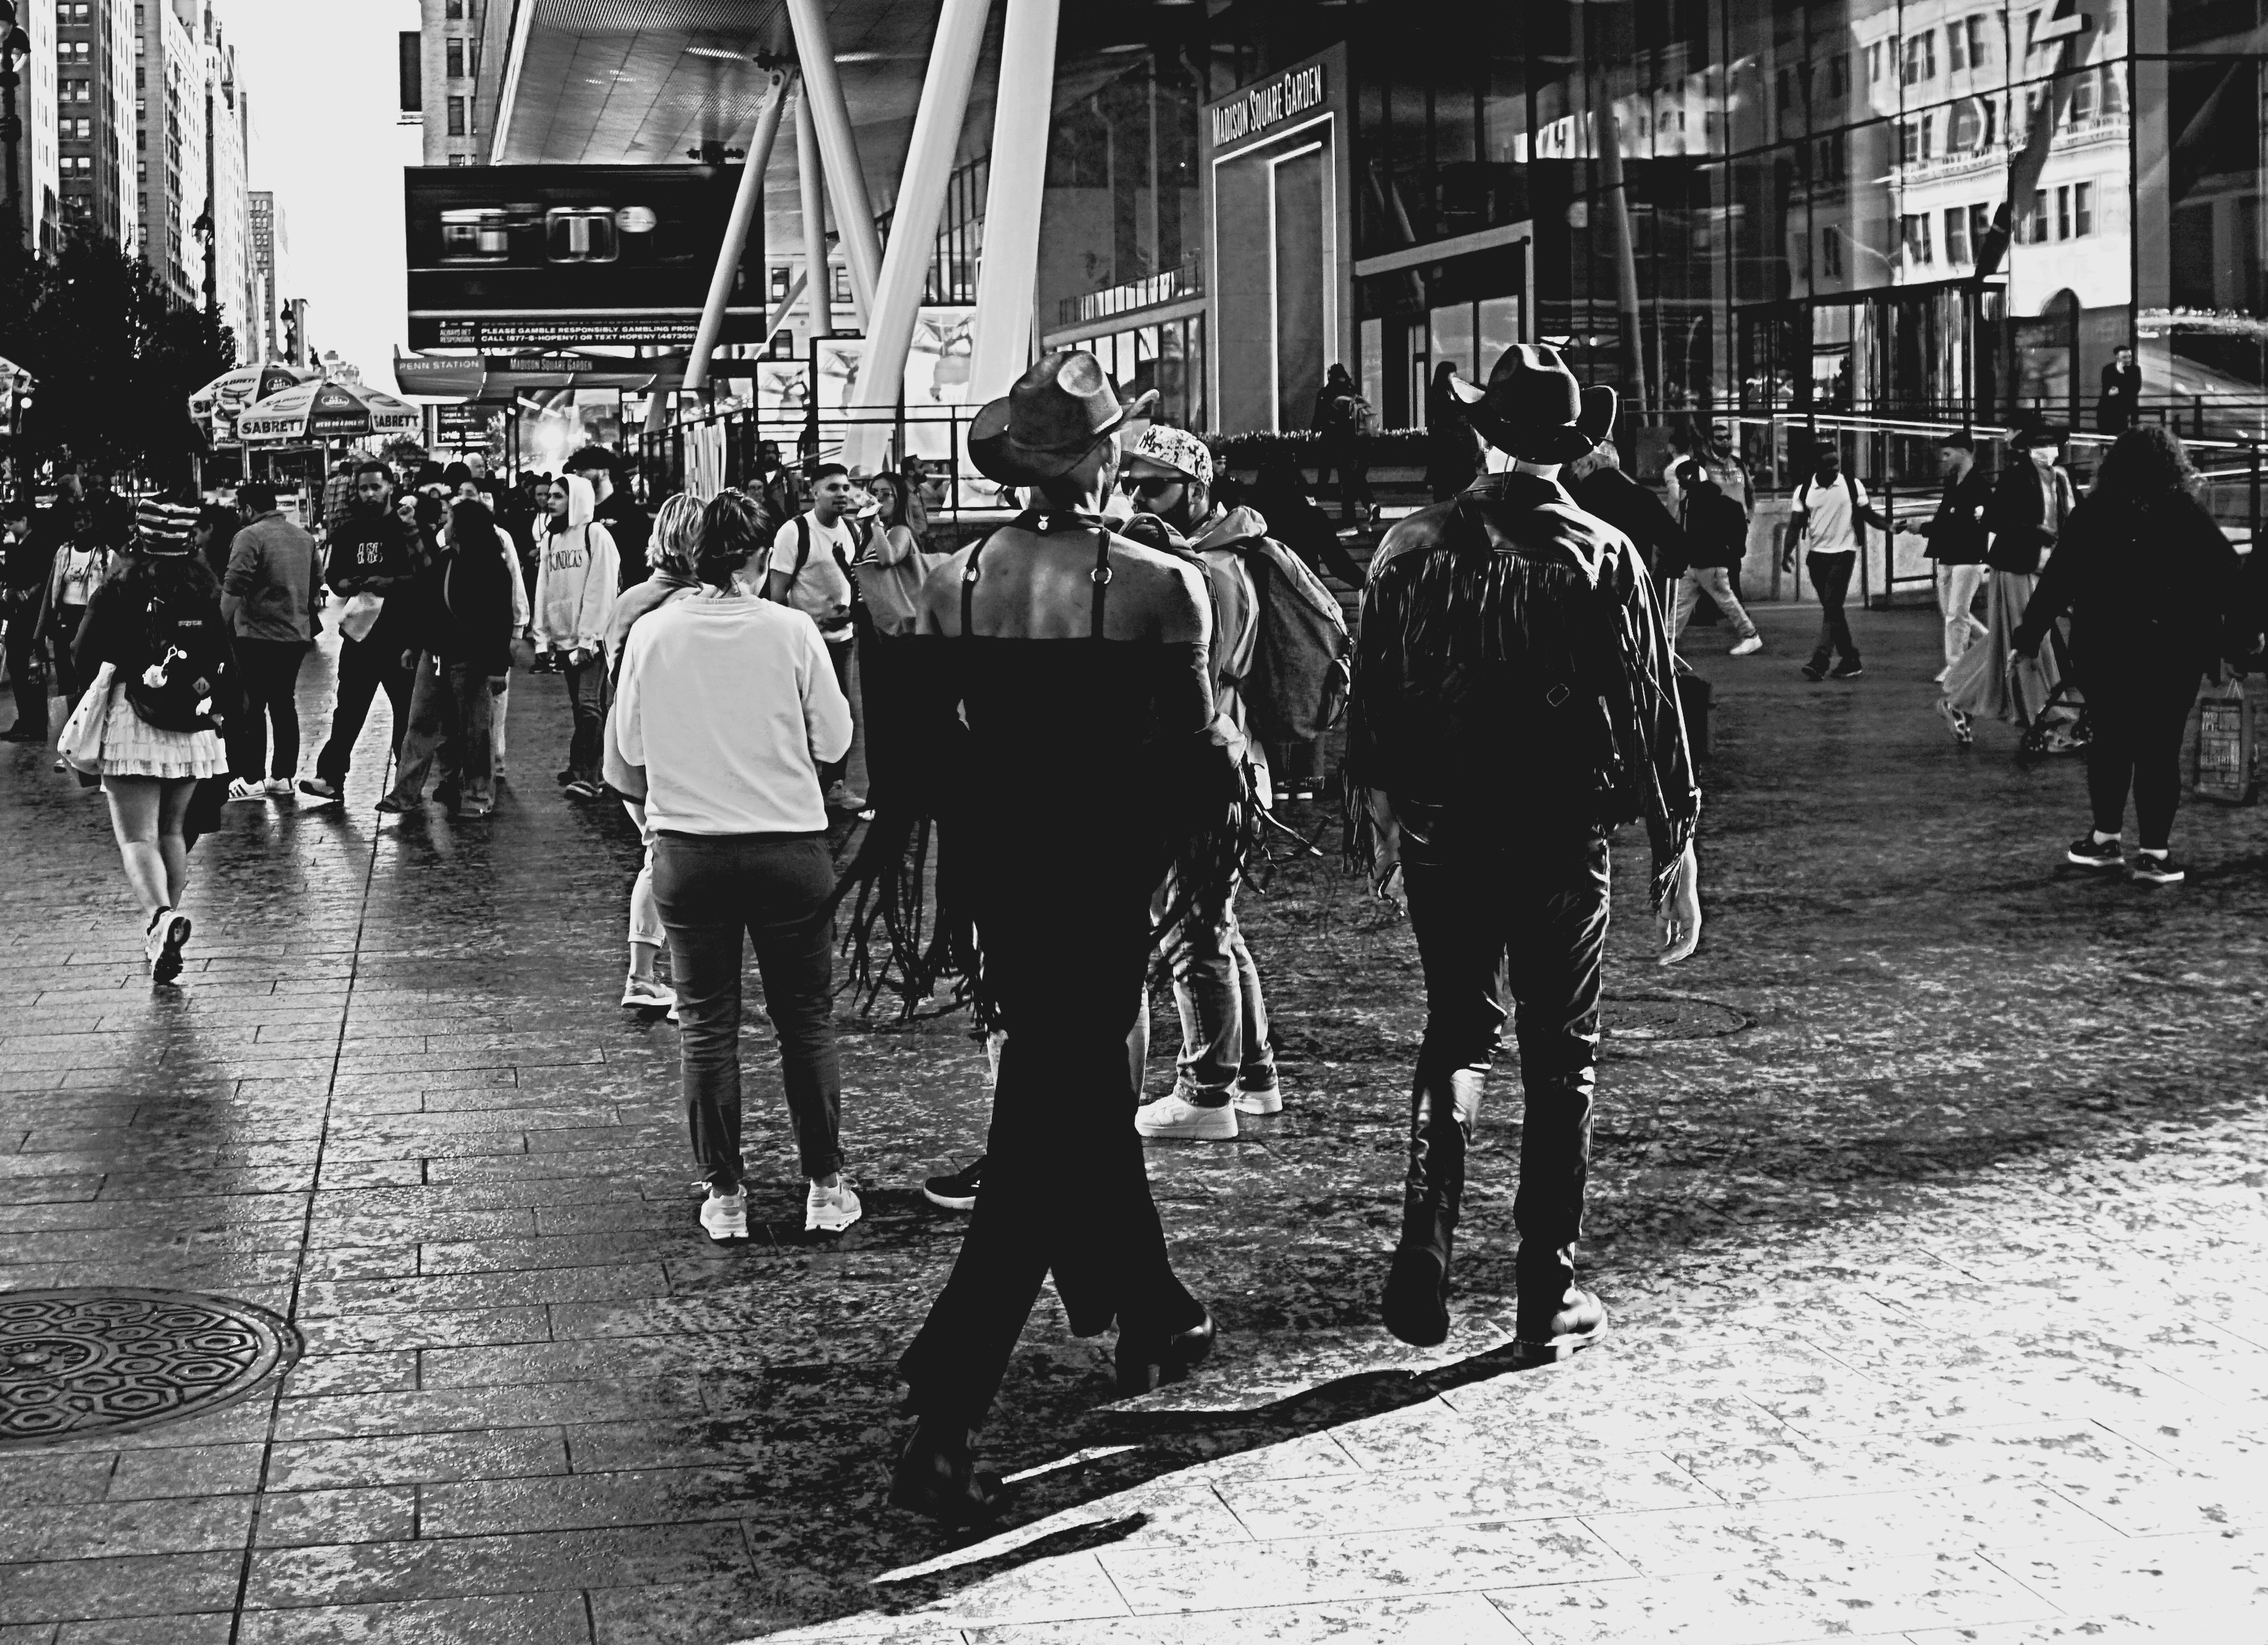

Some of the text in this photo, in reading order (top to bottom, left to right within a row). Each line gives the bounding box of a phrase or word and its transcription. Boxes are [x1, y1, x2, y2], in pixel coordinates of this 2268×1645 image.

[1212, 64, 1322, 147] MADISON SQUARE GARDEN
[399, 360, 480, 370] PENN STATION
[509, 358, 593, 371] MADISON SQUARE GARDEN
[241, 419, 306, 435] SABRETT
